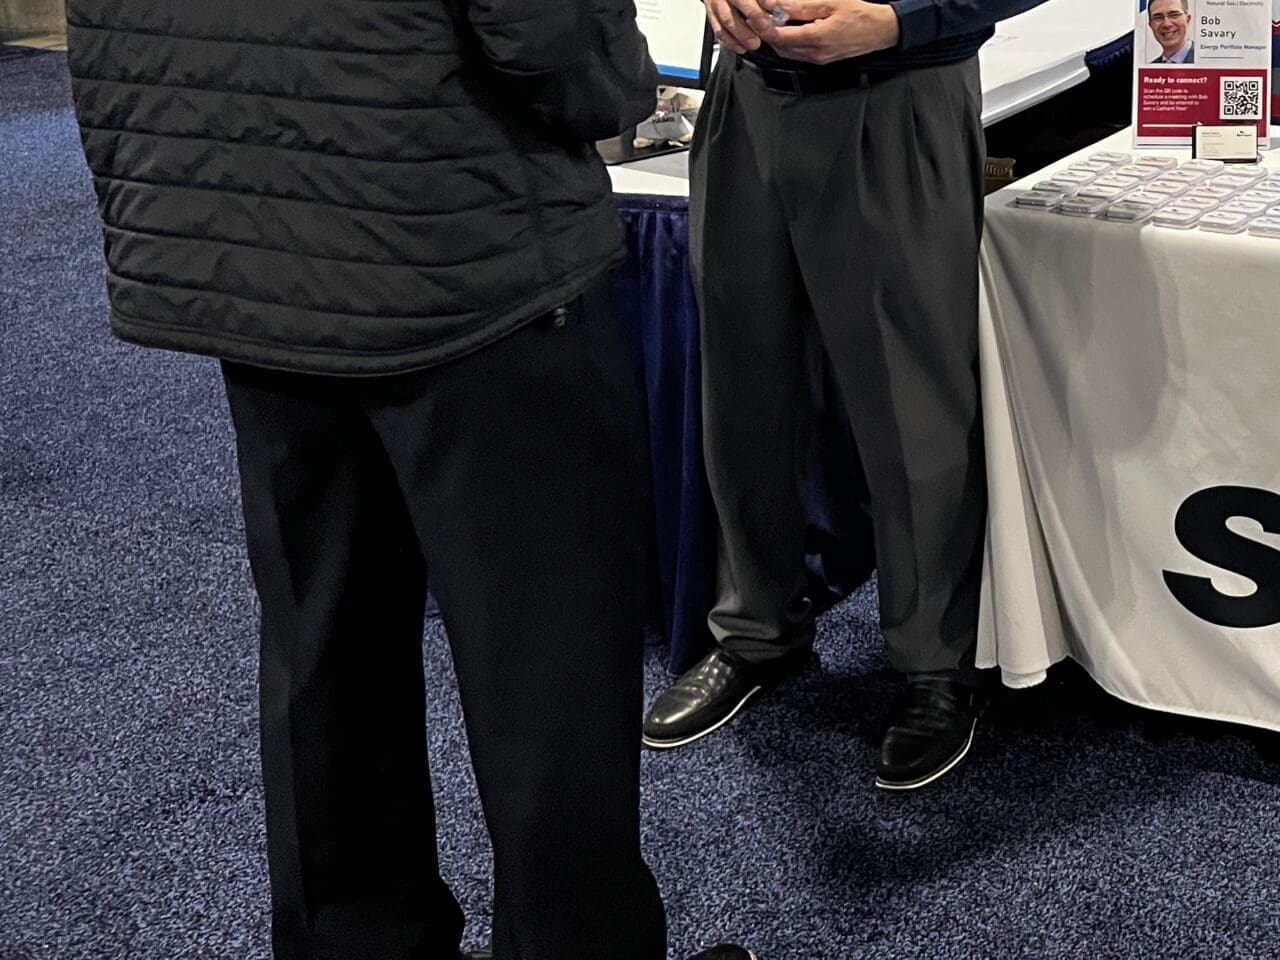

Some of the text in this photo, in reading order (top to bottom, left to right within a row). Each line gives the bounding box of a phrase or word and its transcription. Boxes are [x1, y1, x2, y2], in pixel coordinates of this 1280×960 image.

[1200, 15, 1221, 25] Bob
[1200, 28, 1237, 40] Savary
[1143, 76, 1208, 85] Ready to connect?
